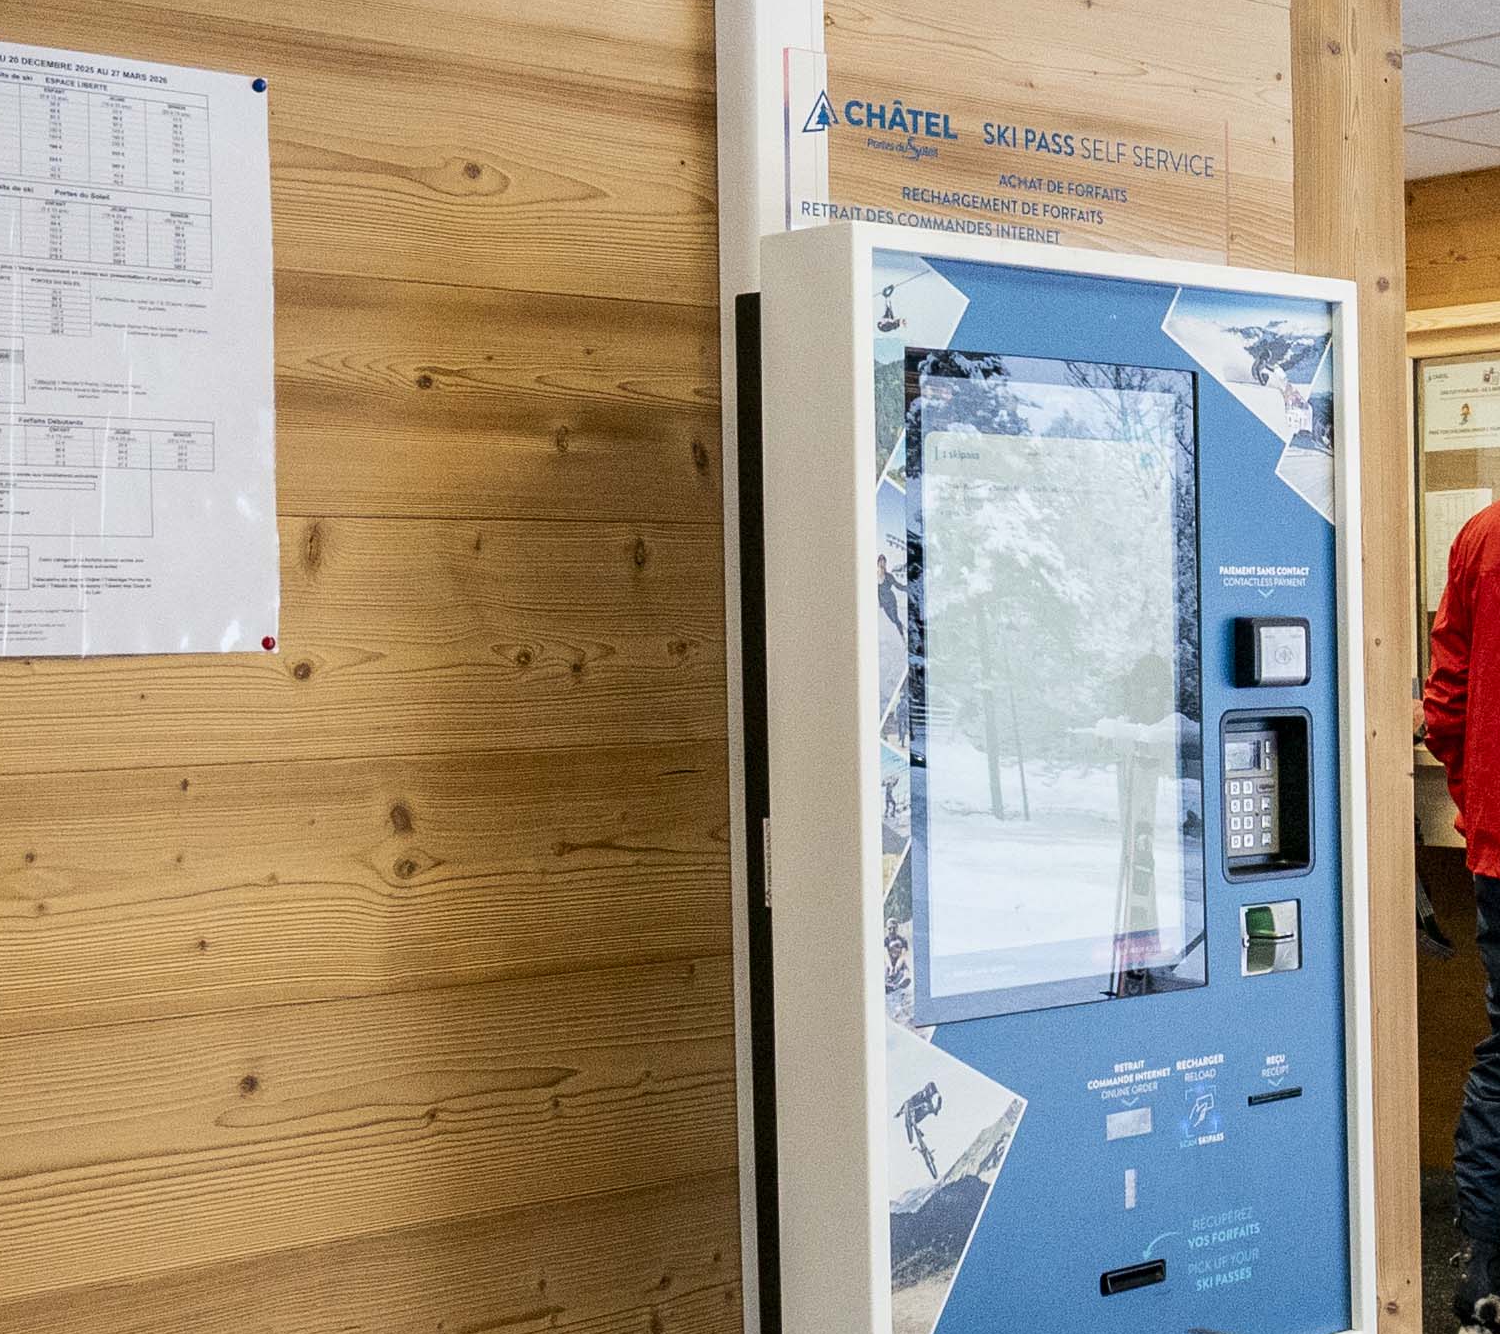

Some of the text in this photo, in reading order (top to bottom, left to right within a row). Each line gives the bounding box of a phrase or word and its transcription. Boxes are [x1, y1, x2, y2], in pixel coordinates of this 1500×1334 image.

[8, 55, 19, 64] 20
[21, 57, 72, 71] DECEMBRE
[75, 64, 94, 73] 2025
[97, 67, 108, 76] AU
[111, 69, 120, 77] 27
[122, 71, 147, 81] MARS
[45, 77, 75, 88] ESPACE
[845, 99, 958, 140] CHÂTEL
[983, 122, 1215, 178] SKI PASS SELF SERVICE
[1000, 173, 1128, 204] ACHAT DE FORFAITS
[902, 186, 1104, 225] RECHARGEMENT DE FORFAITS
[801, 200, 1061, 245] RETRAIT DES COMMANDES INTERNET
[1257, 566, 1275, 575] SANS
[1276, 566, 1310, 575] CONTACT
[1223, 577, 1306, 587] CONTACTLESS PAYMENT
[1114, 1060, 1145, 1074] RETRAIT
[1176, 1053, 1224, 1070] RECHARGER
[1087, 1067, 1171, 1090] COMMANDE INTERNET
[1184, 1068, 1217, 1082] RELOAD
[1101, 1082, 1158, 1100] ONLINE ORDER
[1198, 1133, 1224, 1146] SKIPASS
[1188, 1223, 1261, 1250] VOS FORFAITS
